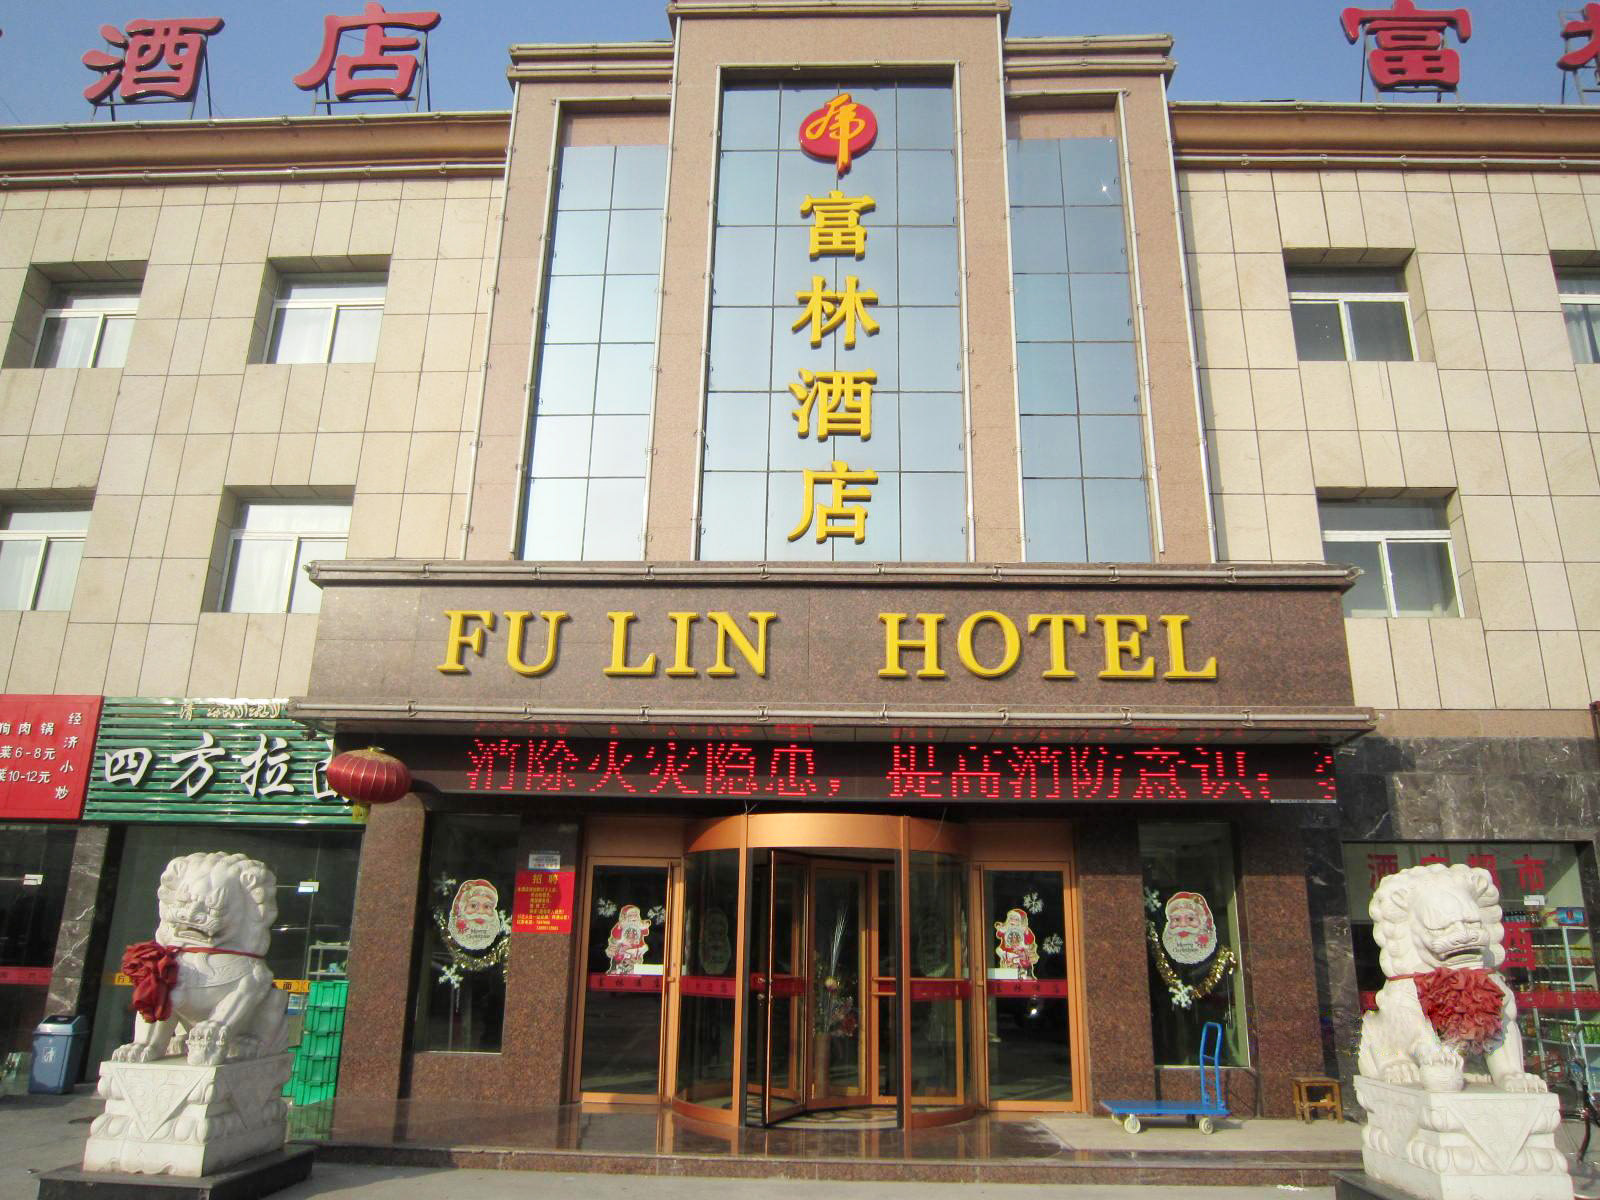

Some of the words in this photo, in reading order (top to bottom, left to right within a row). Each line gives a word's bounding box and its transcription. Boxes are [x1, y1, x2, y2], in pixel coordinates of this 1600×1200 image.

[82, 2, 442, 101] 酒店
[786, 190, 881, 545] 富林酒店
[437, 610, 572, 675] FU
[602, 611, 777, 677] LIN
[877, 609, 1217, 679] HOTEL
[55, 712, 82, 800] 经济小炒
